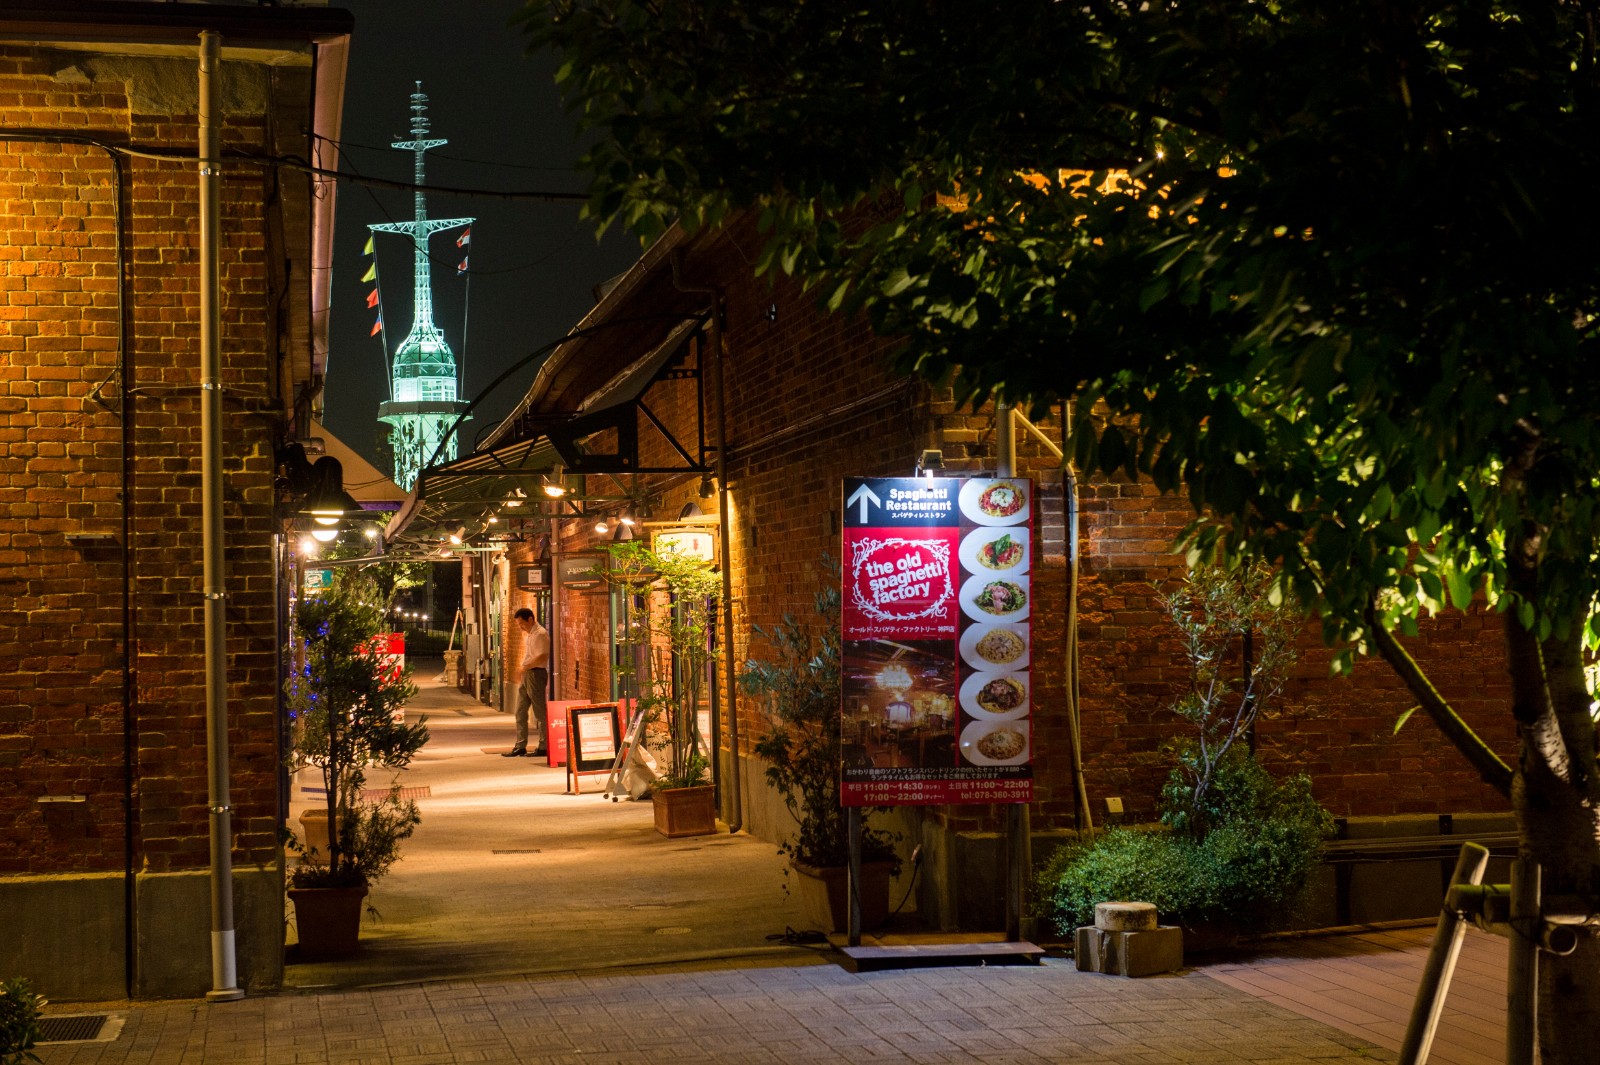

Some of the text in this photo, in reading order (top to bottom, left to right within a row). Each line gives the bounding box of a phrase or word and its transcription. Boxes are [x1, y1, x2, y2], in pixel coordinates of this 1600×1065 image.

[889, 488, 948, 501] Spaghetti
[886, 500, 952, 511] Restaurant
[865, 551, 922, 578] the old
[869, 562, 944, 594] spaghetti
[872, 581, 931, 606] factory
[948, 782, 969, 790] 土日祝
[961, 790, 1030, 799] tel:078-360-3911
